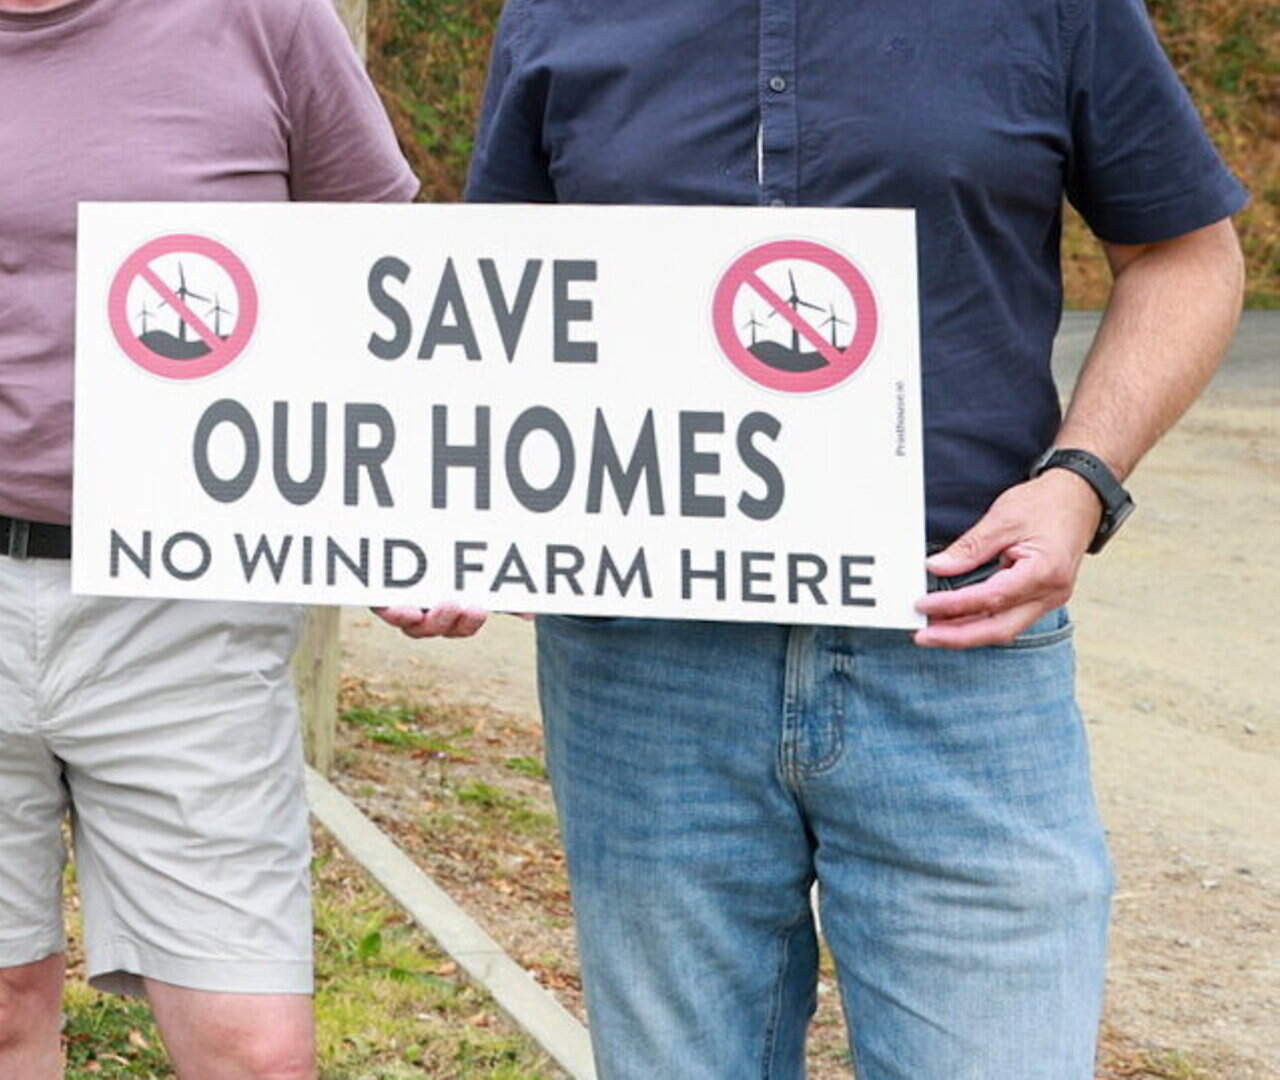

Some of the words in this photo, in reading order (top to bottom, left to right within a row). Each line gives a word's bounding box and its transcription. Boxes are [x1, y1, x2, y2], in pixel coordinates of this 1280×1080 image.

[367, 256, 599, 363] SAVE
[193, 399, 396, 507] OUR
[432, 404, 786, 521] HOMES
[109, 529, 212, 582] NO
[234, 533, 429, 589] WIND
[454, 541, 653, 598] FARM
[680, 549, 877, 607] HERE
